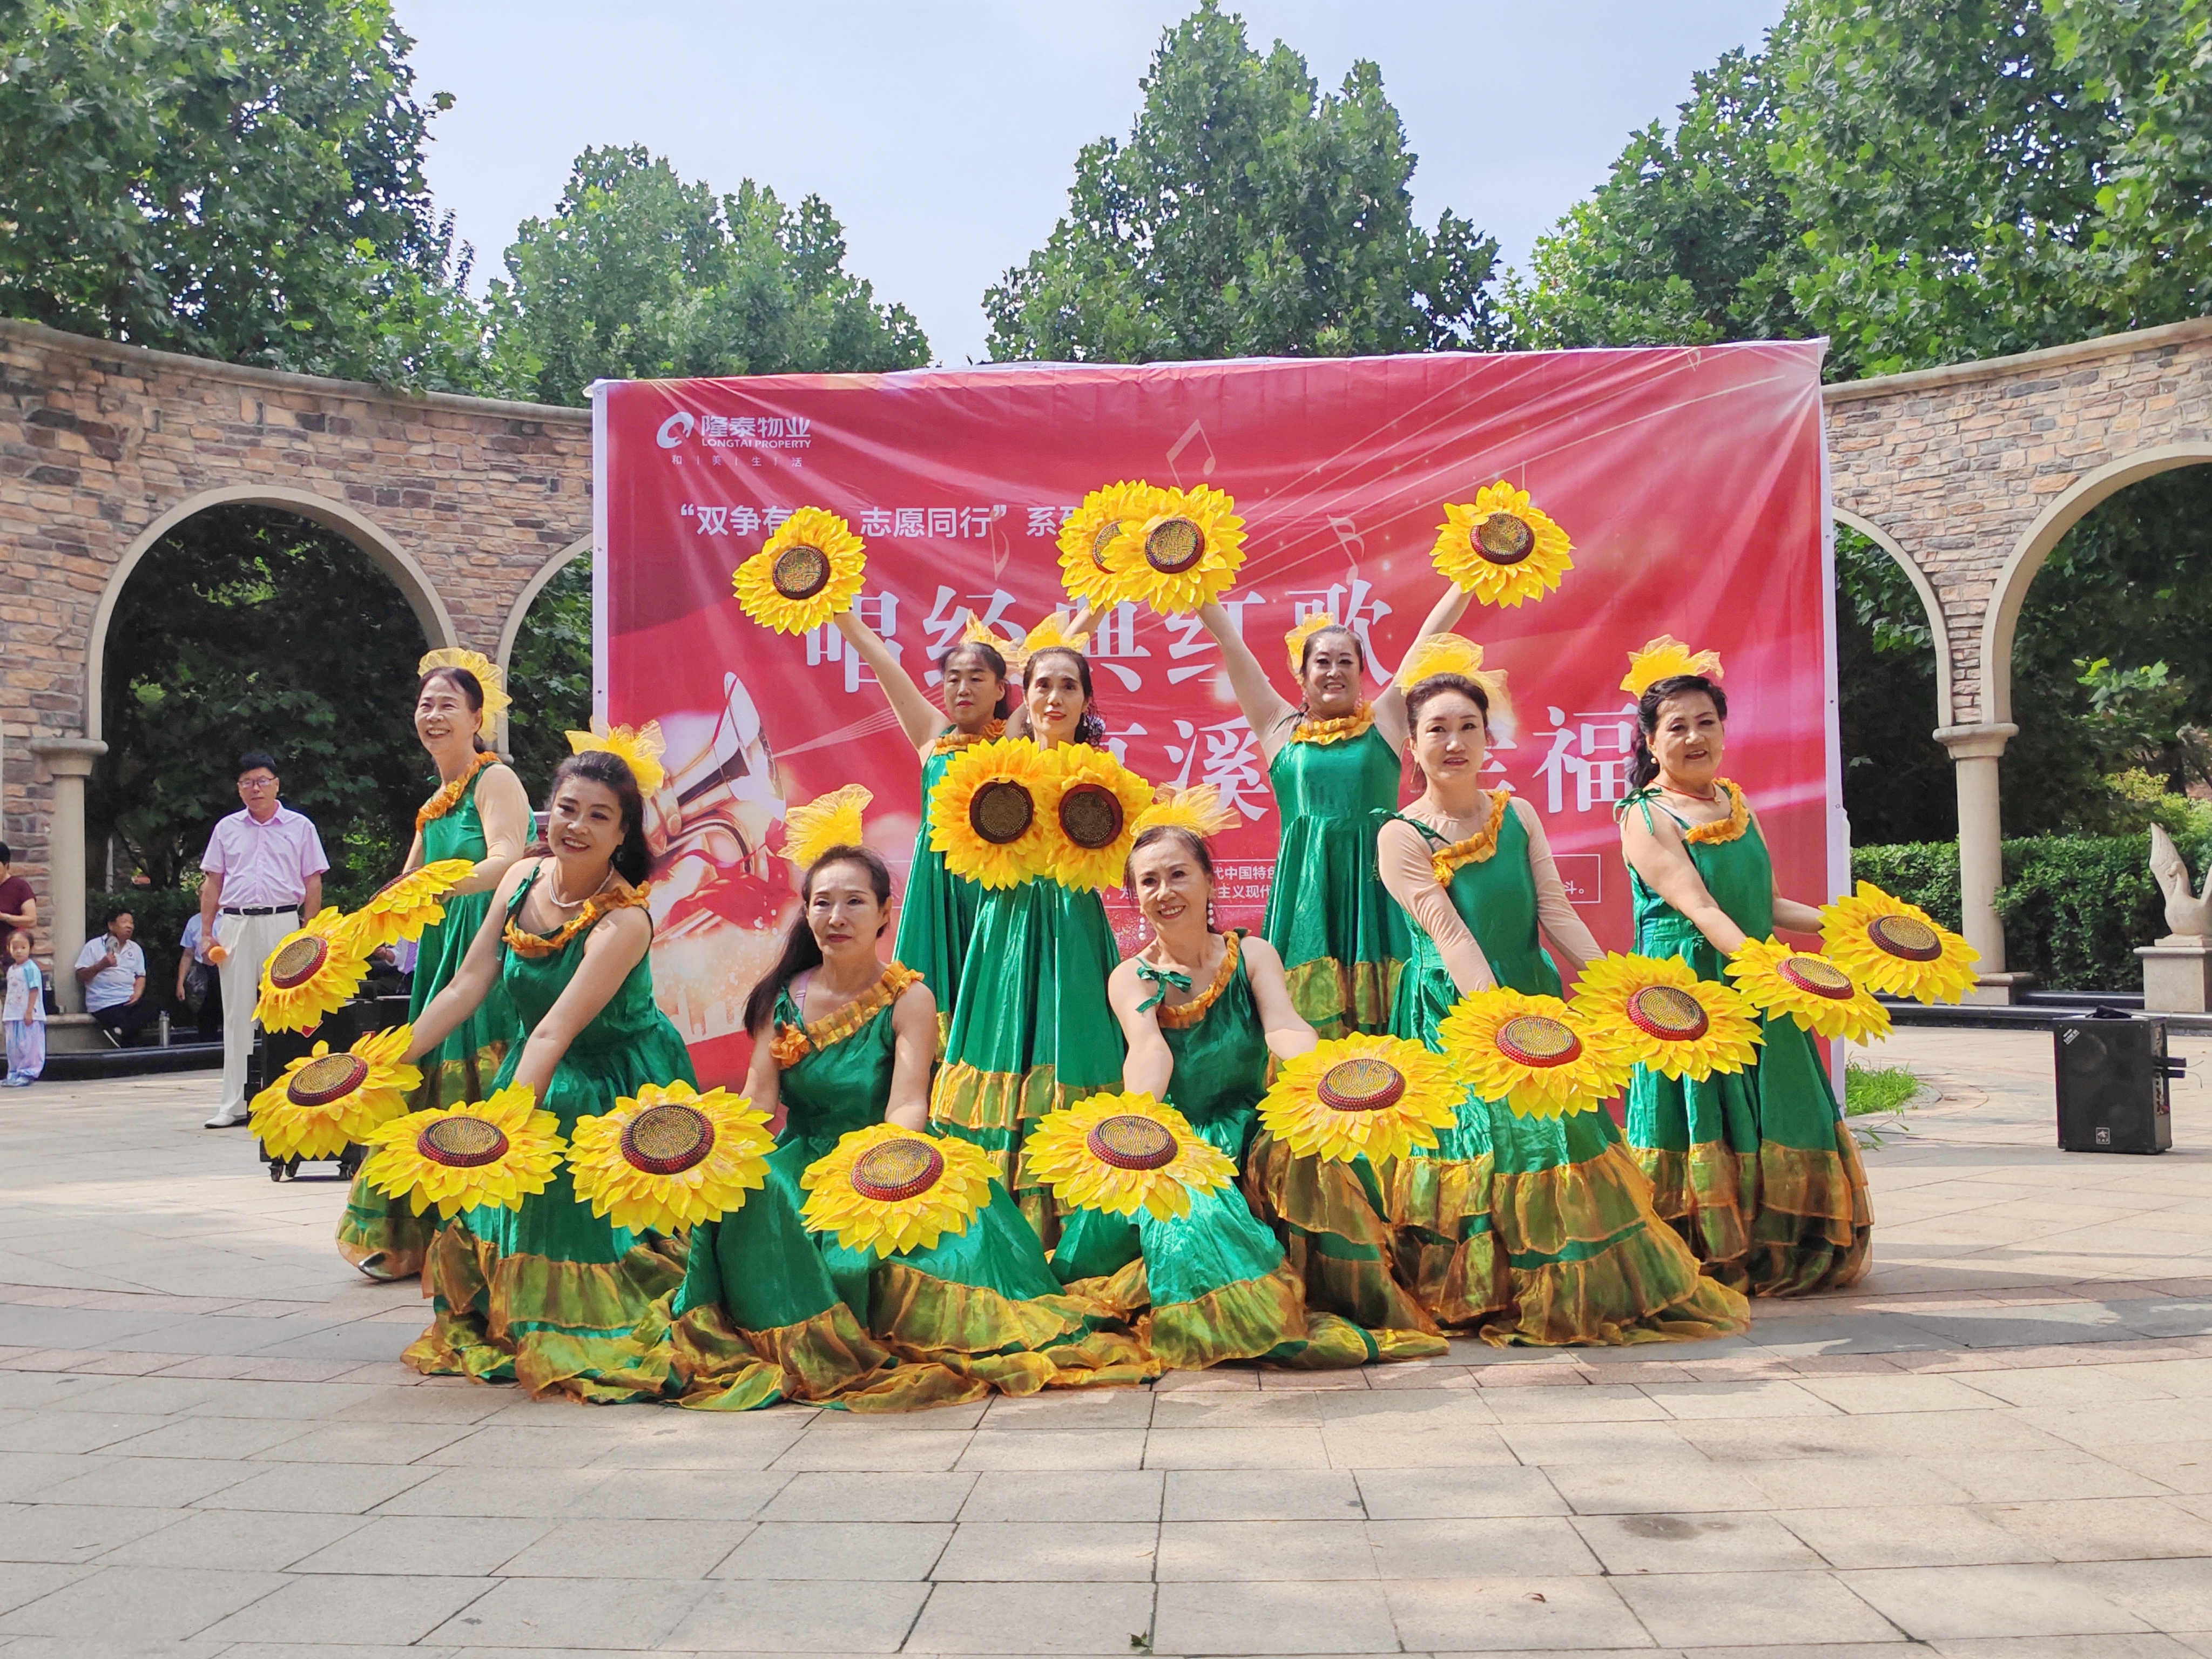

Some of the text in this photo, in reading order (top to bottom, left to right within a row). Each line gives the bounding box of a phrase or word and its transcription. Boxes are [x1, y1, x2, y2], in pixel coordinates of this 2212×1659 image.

[701, 415, 811, 437] 隆泰物业
[702, 439, 811, 449] LONGTAI PROPERTY
[680, 503, 799, 536] “双争有
[860, 504, 1007, 538] 志愿同行”
